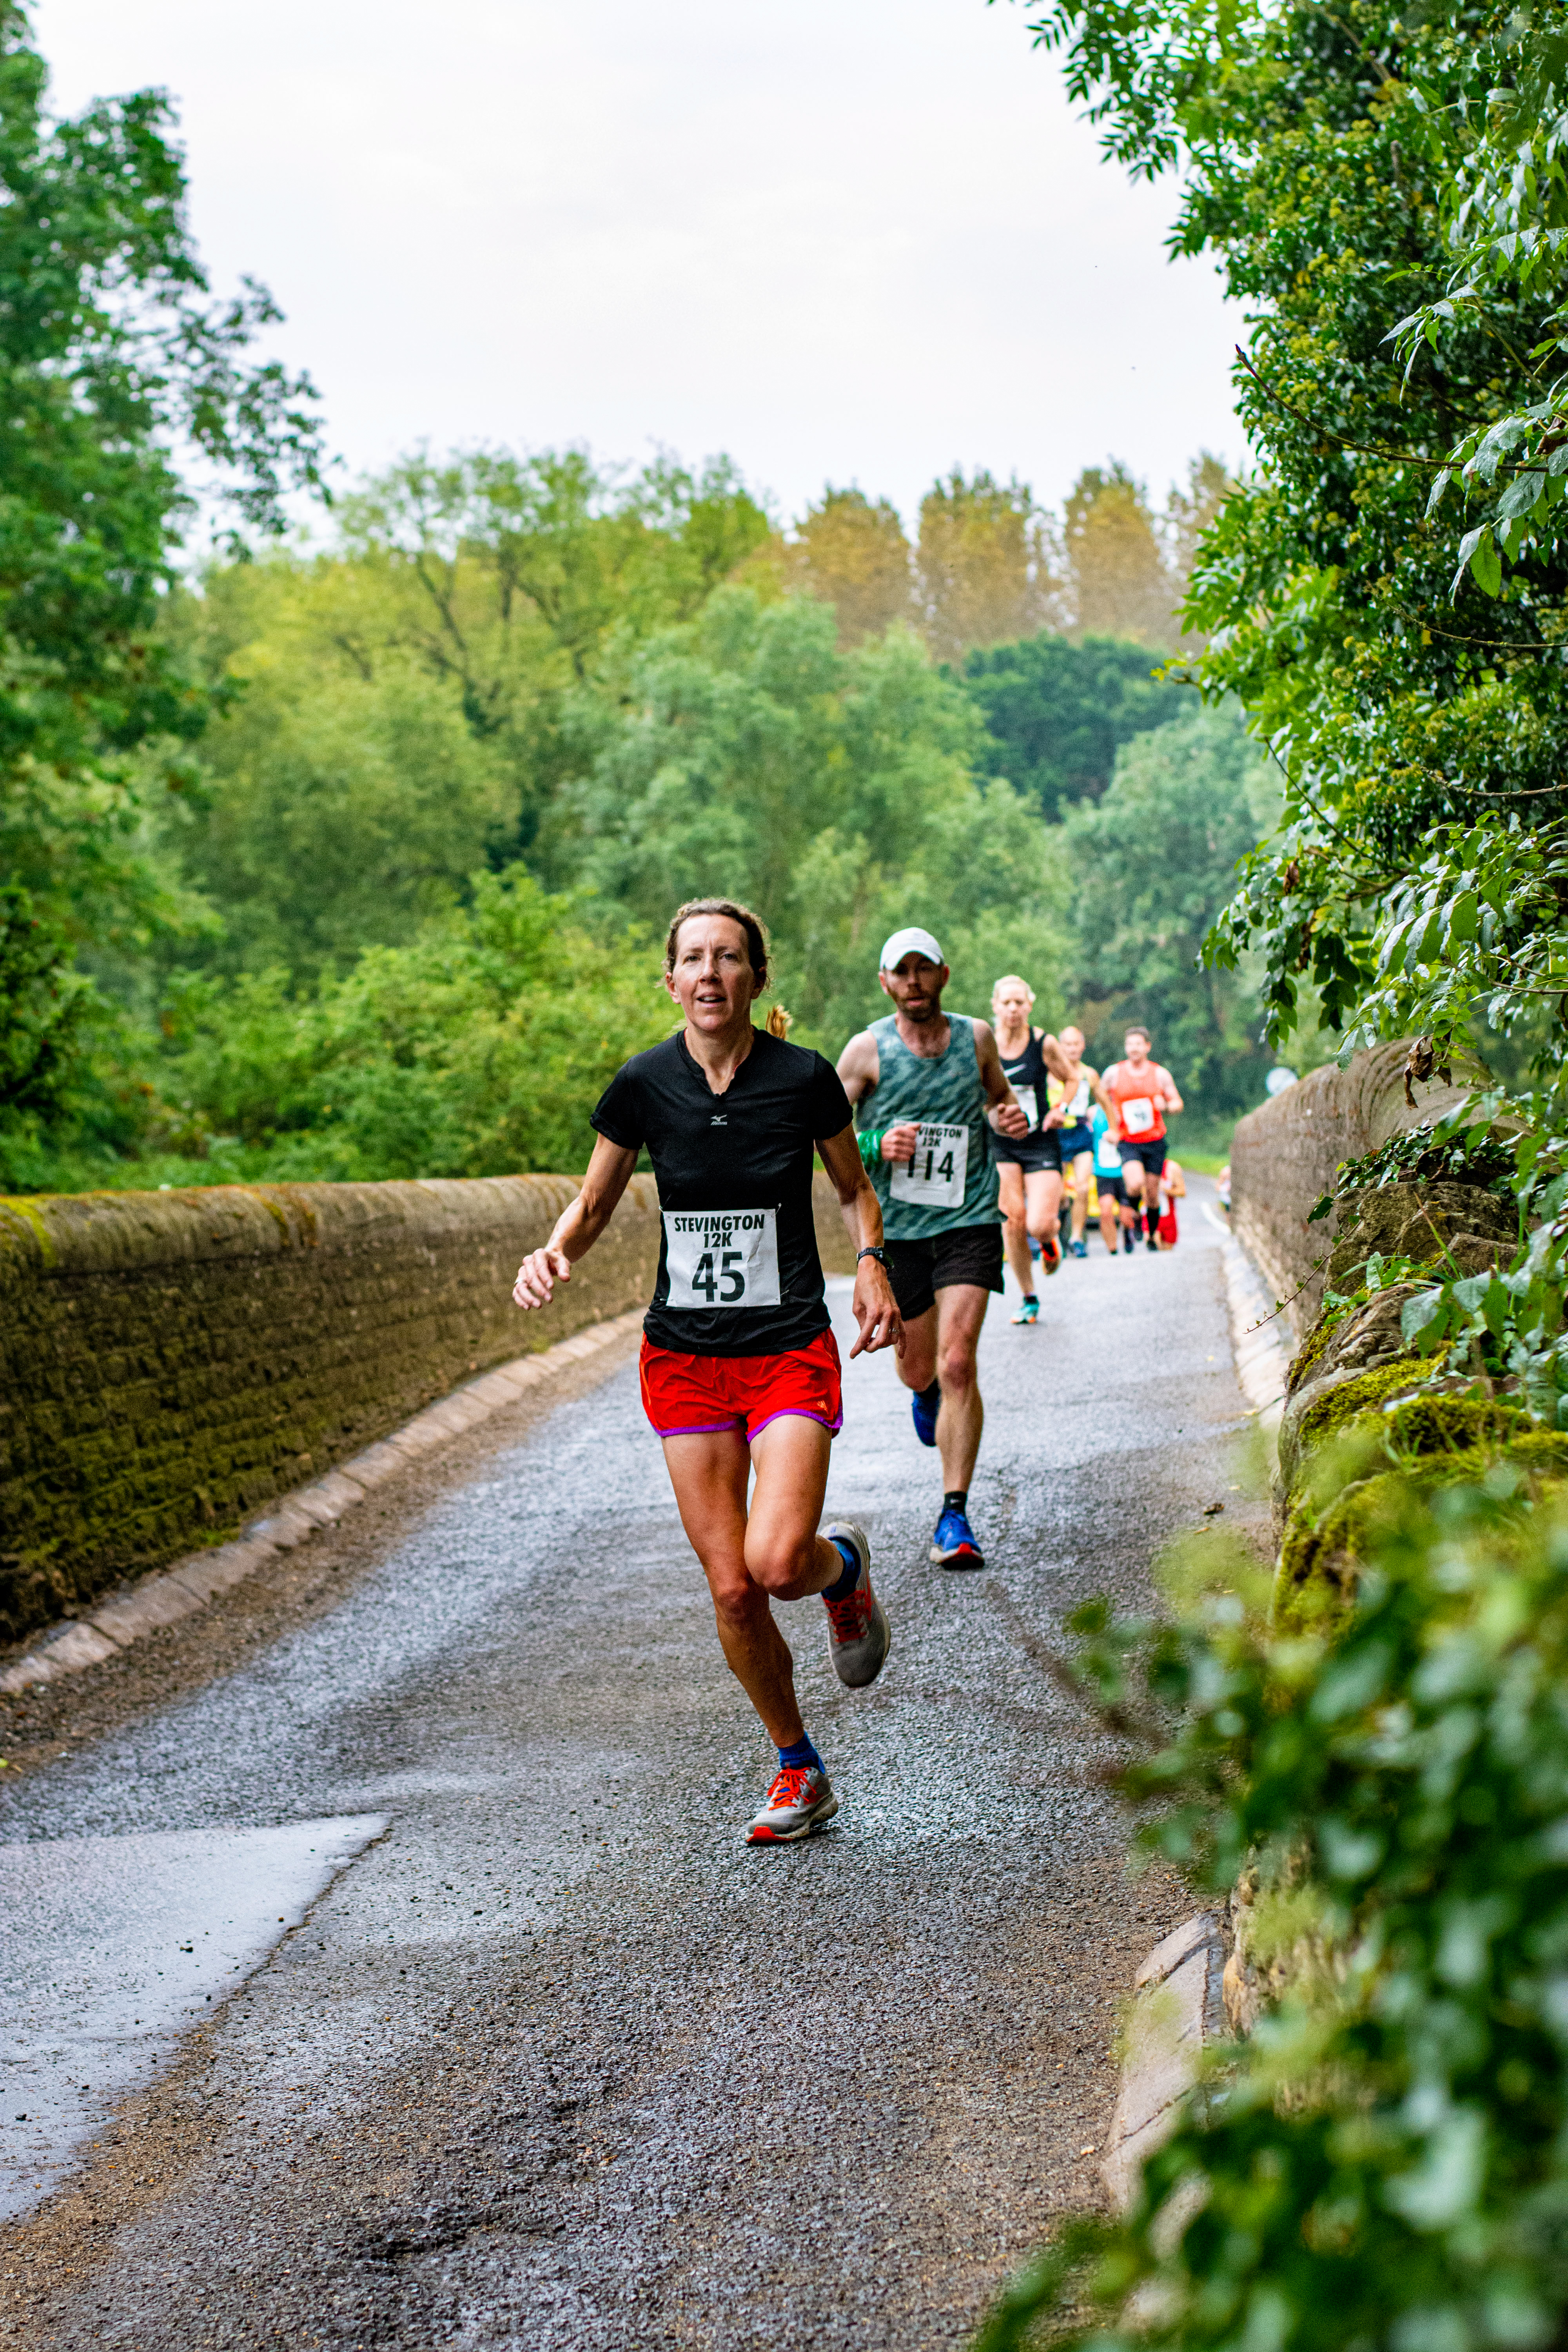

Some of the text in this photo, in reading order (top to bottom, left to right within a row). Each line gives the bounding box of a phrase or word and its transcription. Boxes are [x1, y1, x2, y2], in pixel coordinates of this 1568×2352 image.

[919, 1127, 962, 1138] VINGTON
[922, 1137, 941, 1147] 12K
[908, 1150, 954, 1182] 114
[675, 1214, 765, 1232] STEVINGTON
[704, 1232, 733, 1248] 12K
[692, 1252, 745, 1302] 45
